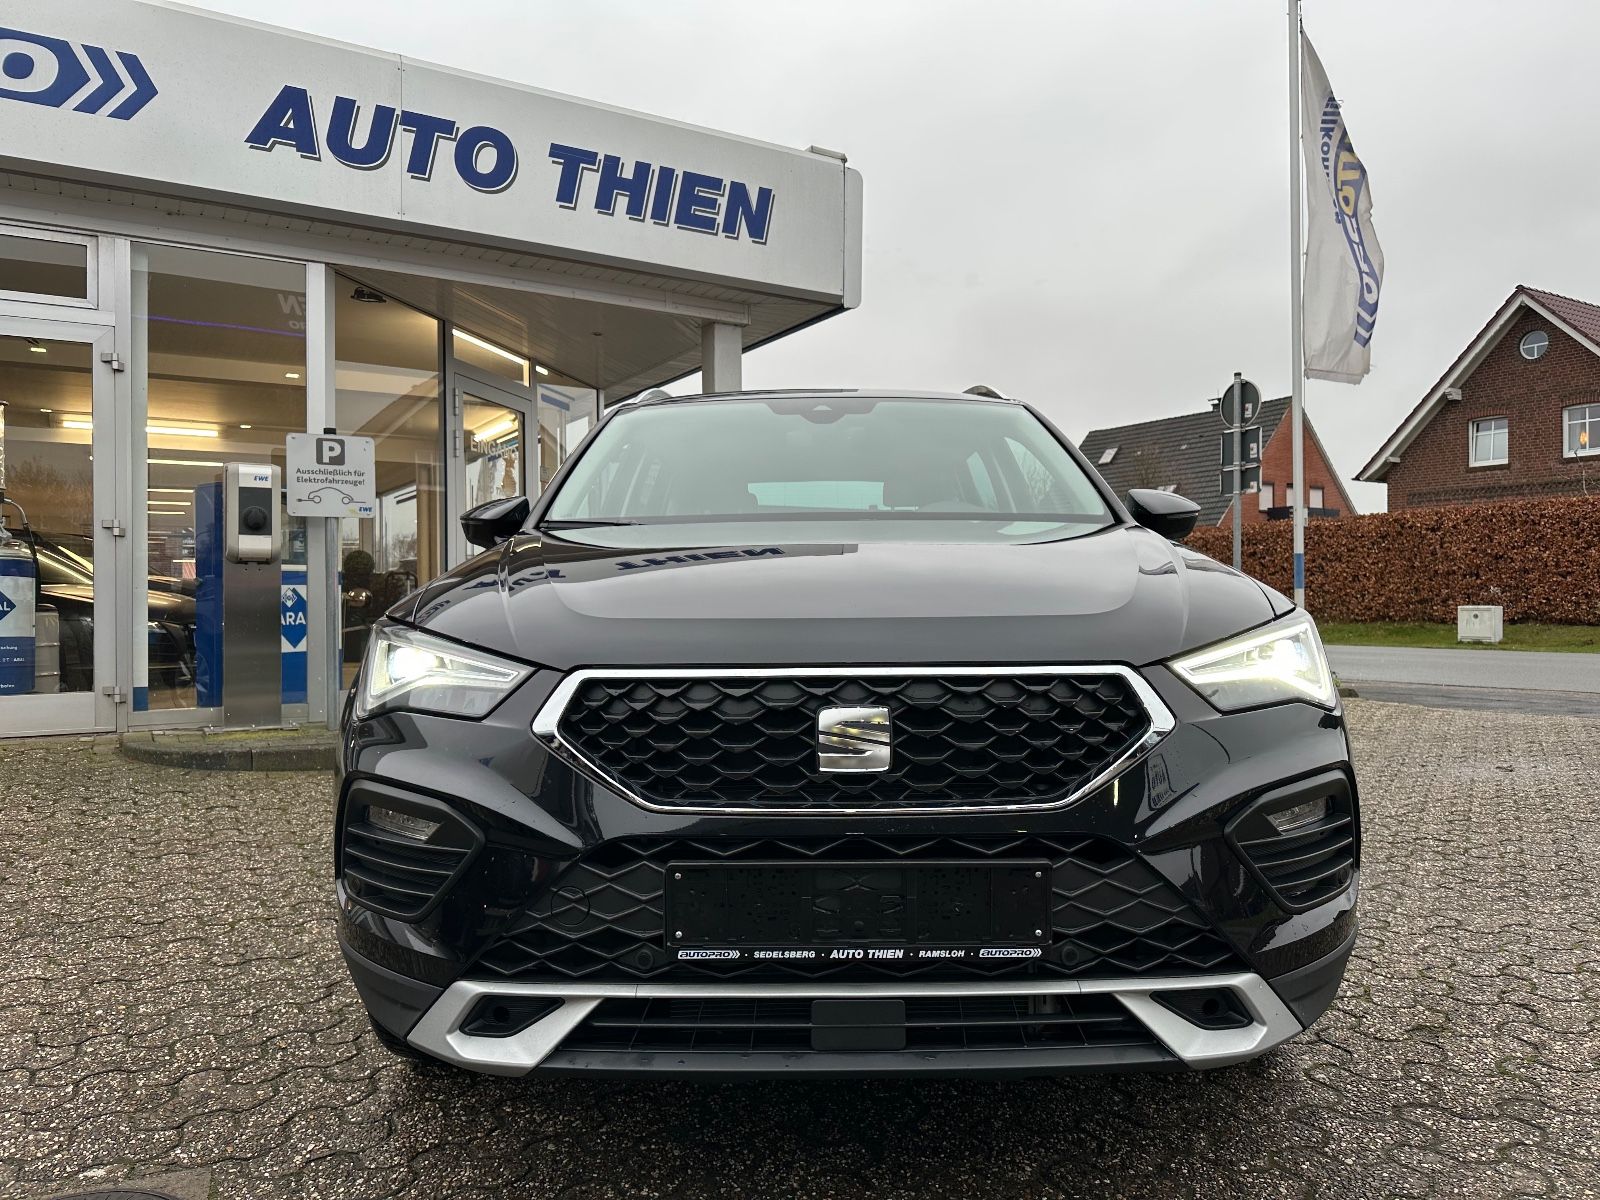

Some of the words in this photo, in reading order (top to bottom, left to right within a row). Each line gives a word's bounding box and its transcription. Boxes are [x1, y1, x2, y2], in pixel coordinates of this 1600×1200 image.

[244, 84, 519, 195] AUTO
[548, 142, 775, 246] THIEN
[322, 440, 341, 463] P
[296, 468, 352, 477] Ausschließlich
[353, 469, 365, 478] für
[296, 477, 365, 487] Elektrofahrzeuge!
[753, 951, 816, 959] SEDELSBERG
[829, 950, 864, 959] AUTO
[867, 949, 904, 959] THIEN
[918, 950, 965, 958] RAMSLOH
